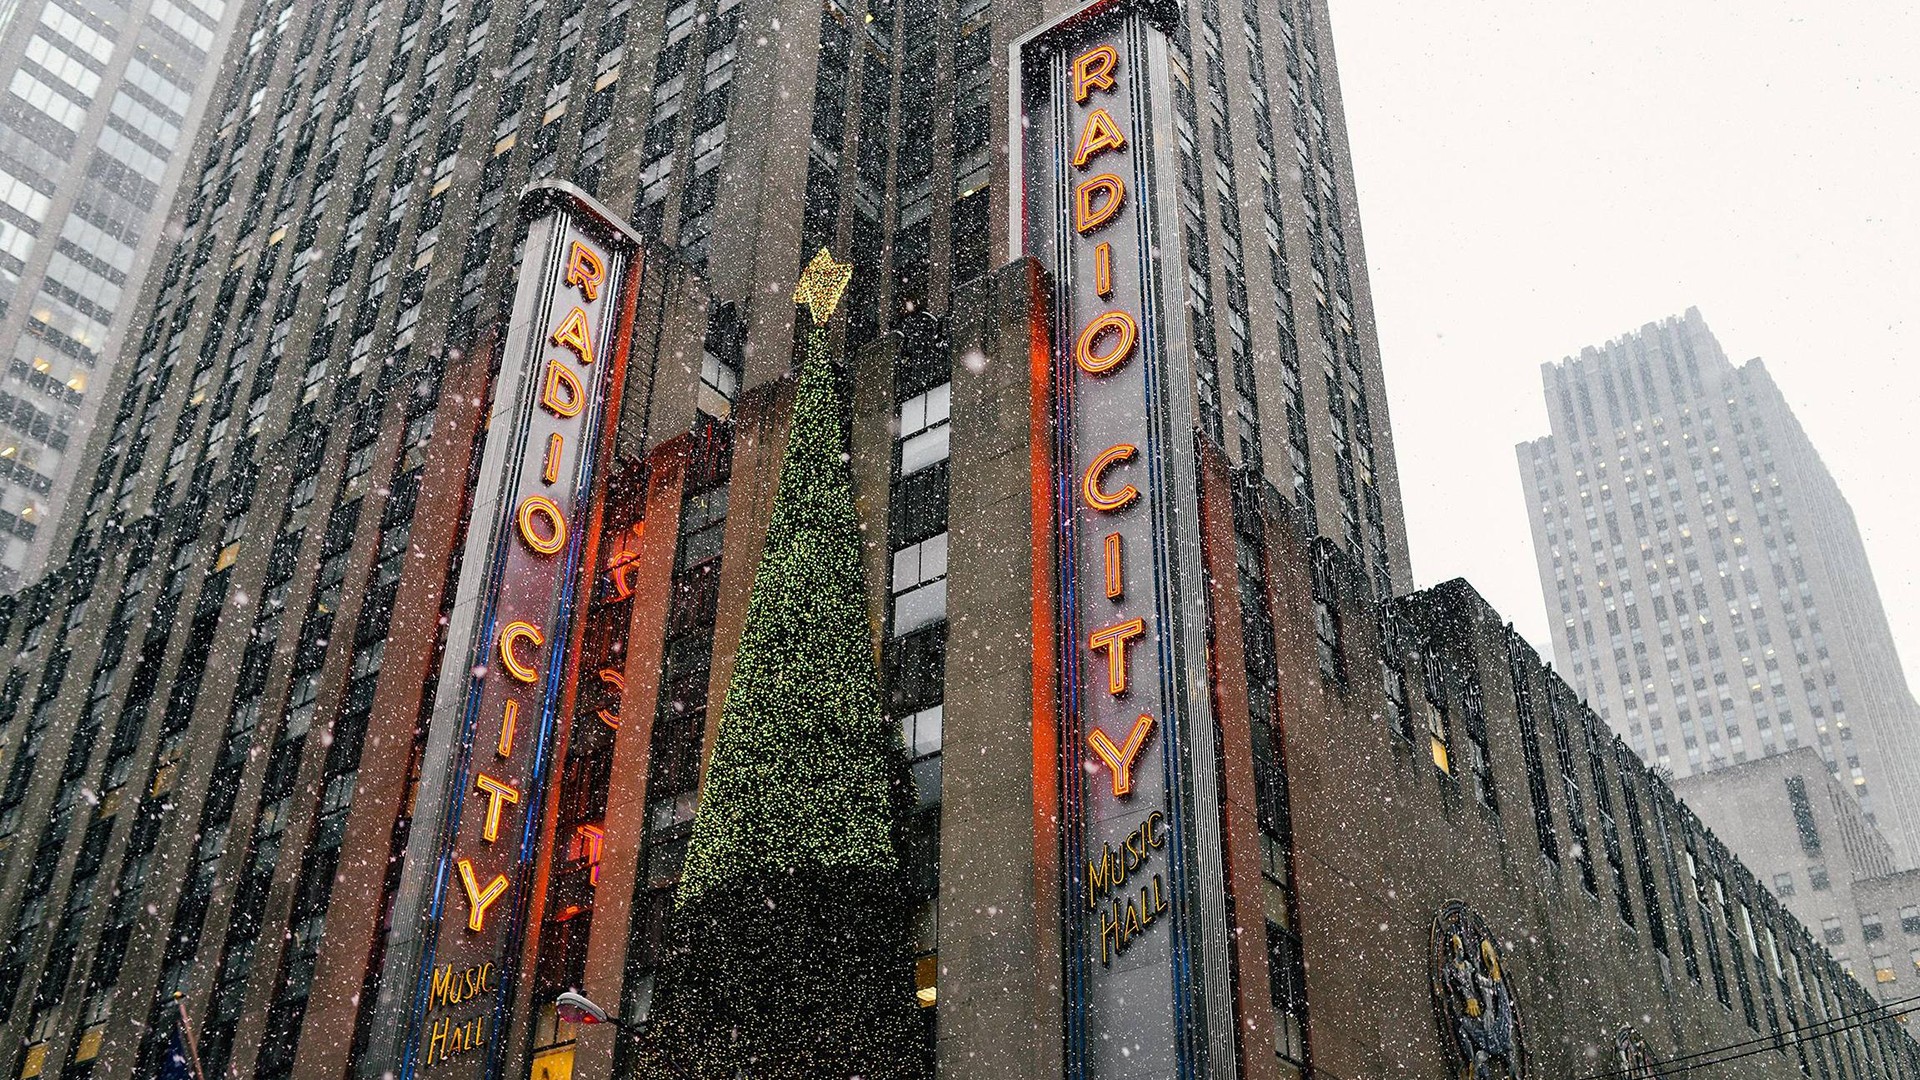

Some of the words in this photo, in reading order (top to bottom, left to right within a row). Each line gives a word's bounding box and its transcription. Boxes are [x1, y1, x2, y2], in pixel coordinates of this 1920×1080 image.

[1073, 44, 1138, 375] RADIO
[518, 240, 605, 554] RADIO
[457, 621, 544, 932] CITY
[1082, 443, 1156, 796] CITY
